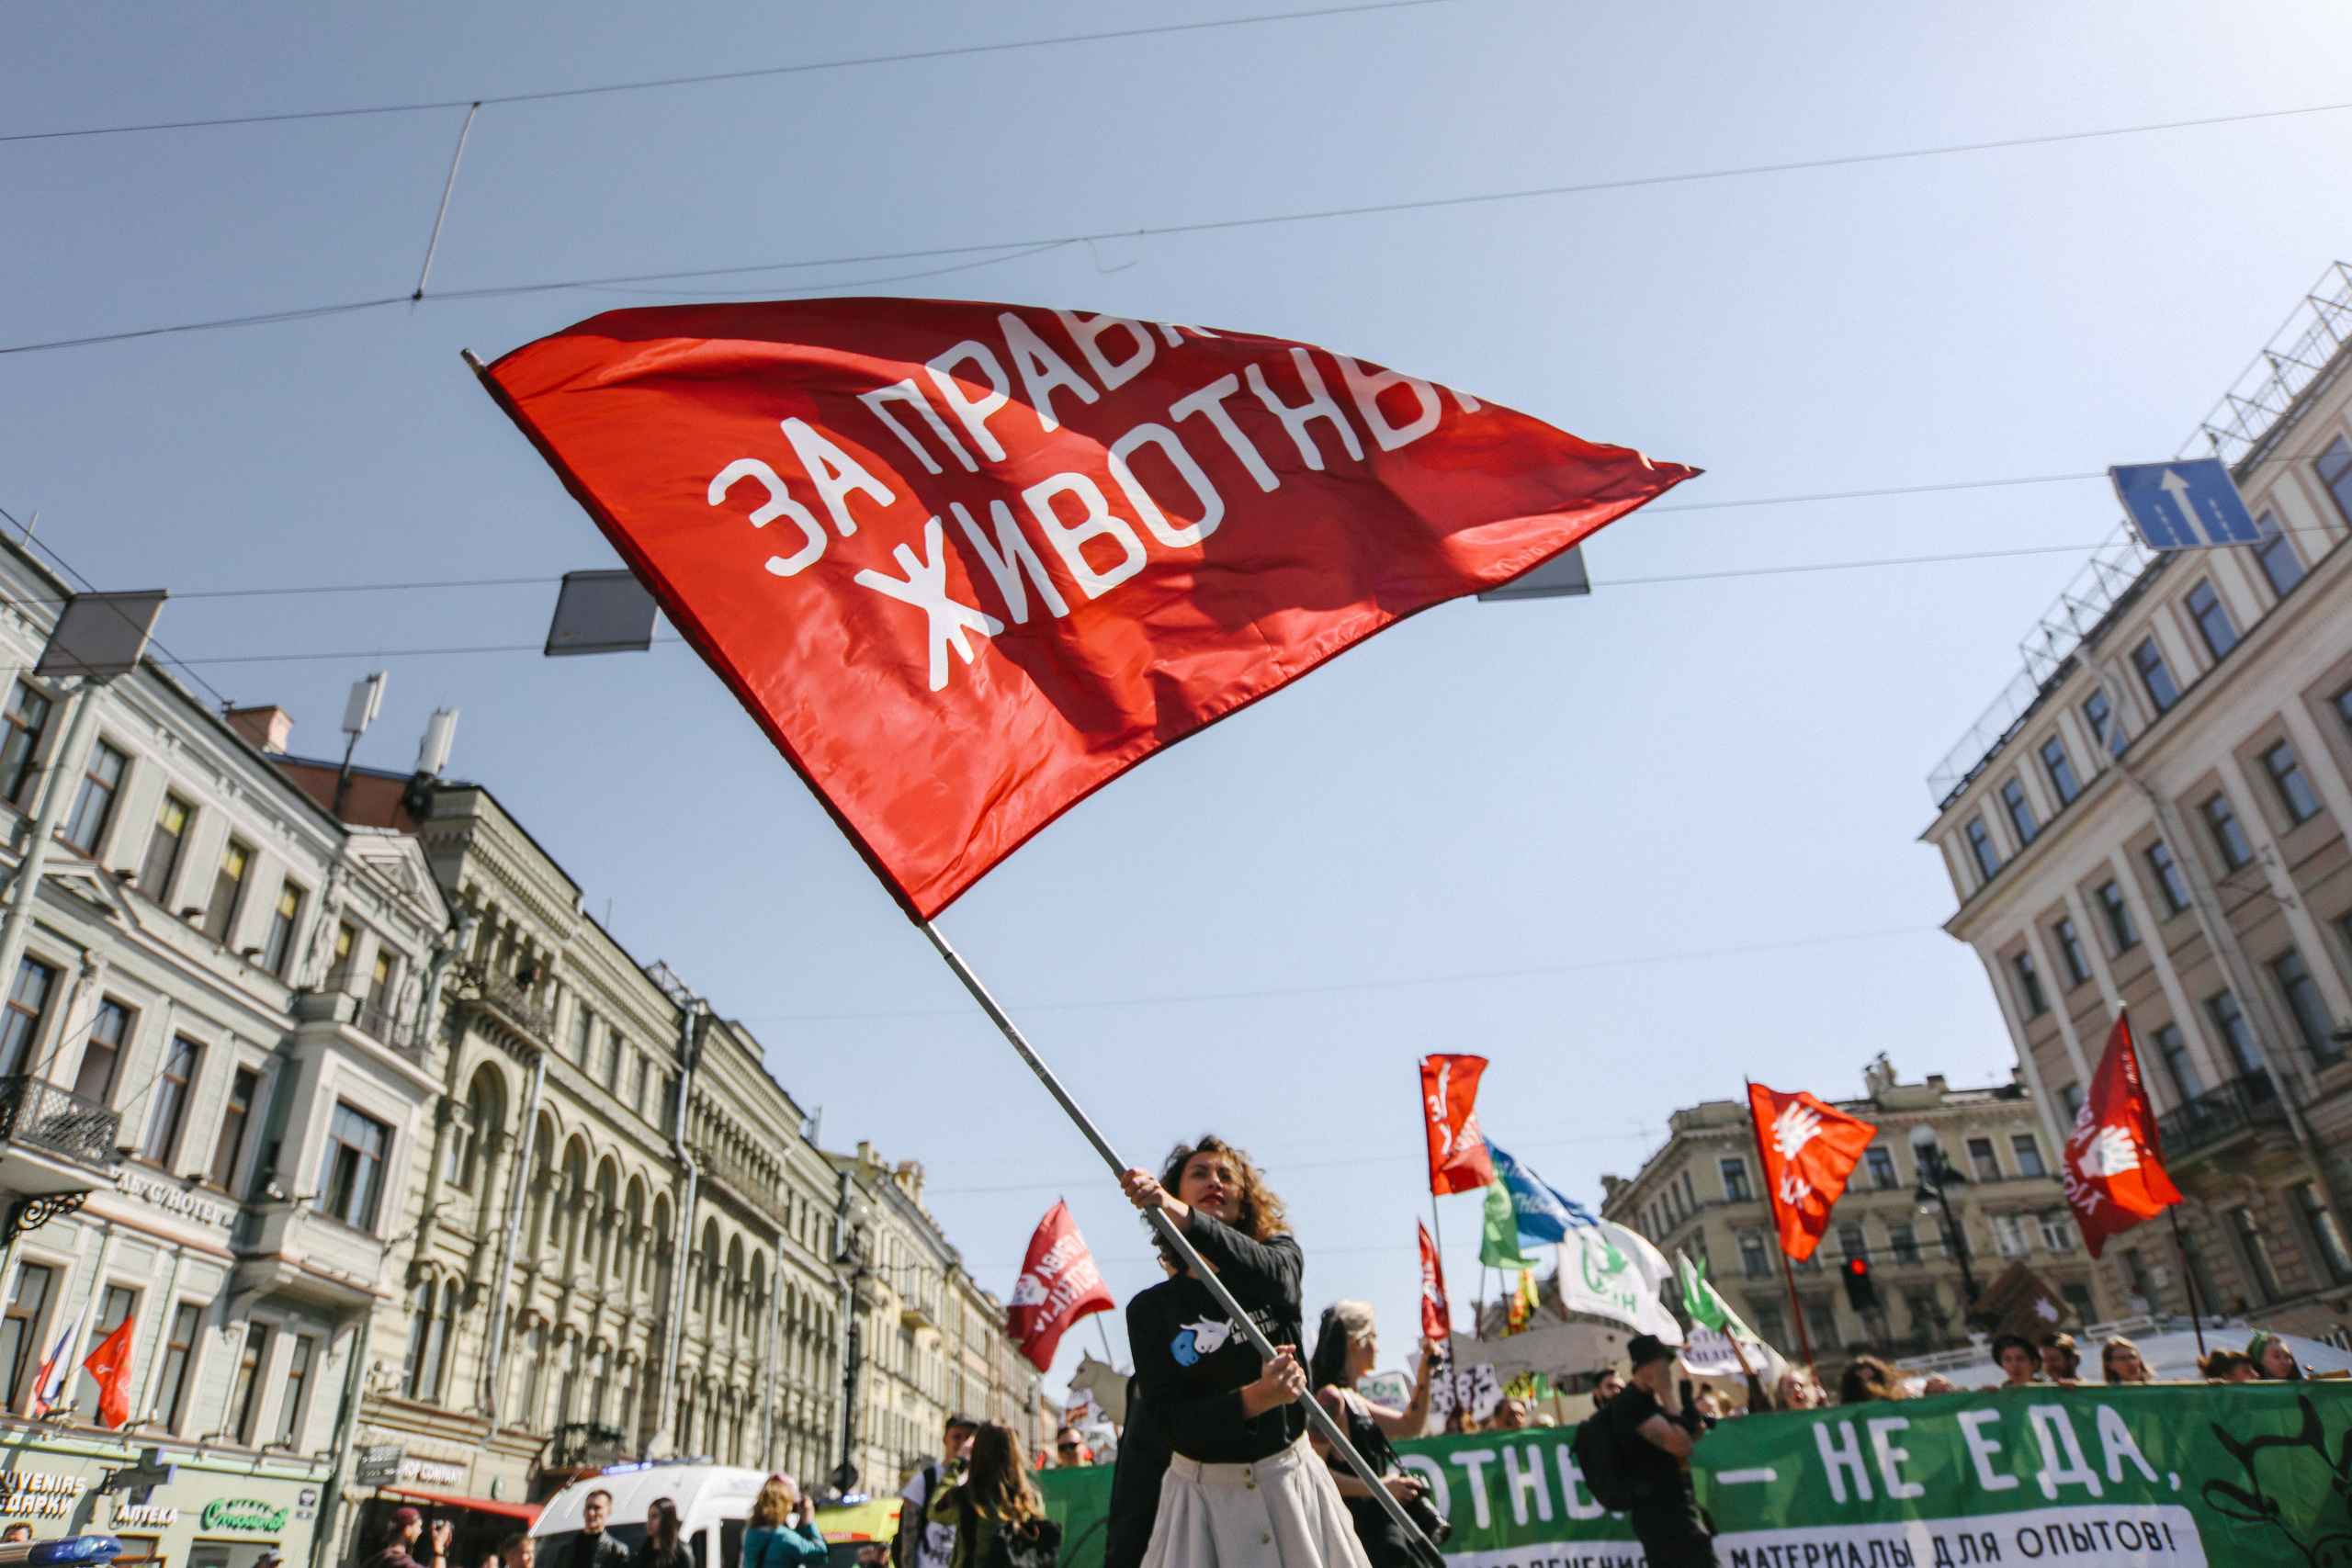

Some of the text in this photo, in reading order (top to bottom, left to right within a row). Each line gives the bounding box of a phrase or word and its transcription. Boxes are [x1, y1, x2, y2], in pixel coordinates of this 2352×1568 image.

[707, 309, 1221, 577] ЗА ПРАВ
[1813, 1416, 1926, 1504] НЕ
[1957, 1404, 2182, 1501] ЕДА,
[116, 1504, 179, 1524] АПТЕКА
[1932, 1532, 2001, 1568] ДЛЯ
[2017, 1520, 2177, 1559] ОПЫТОВ!
